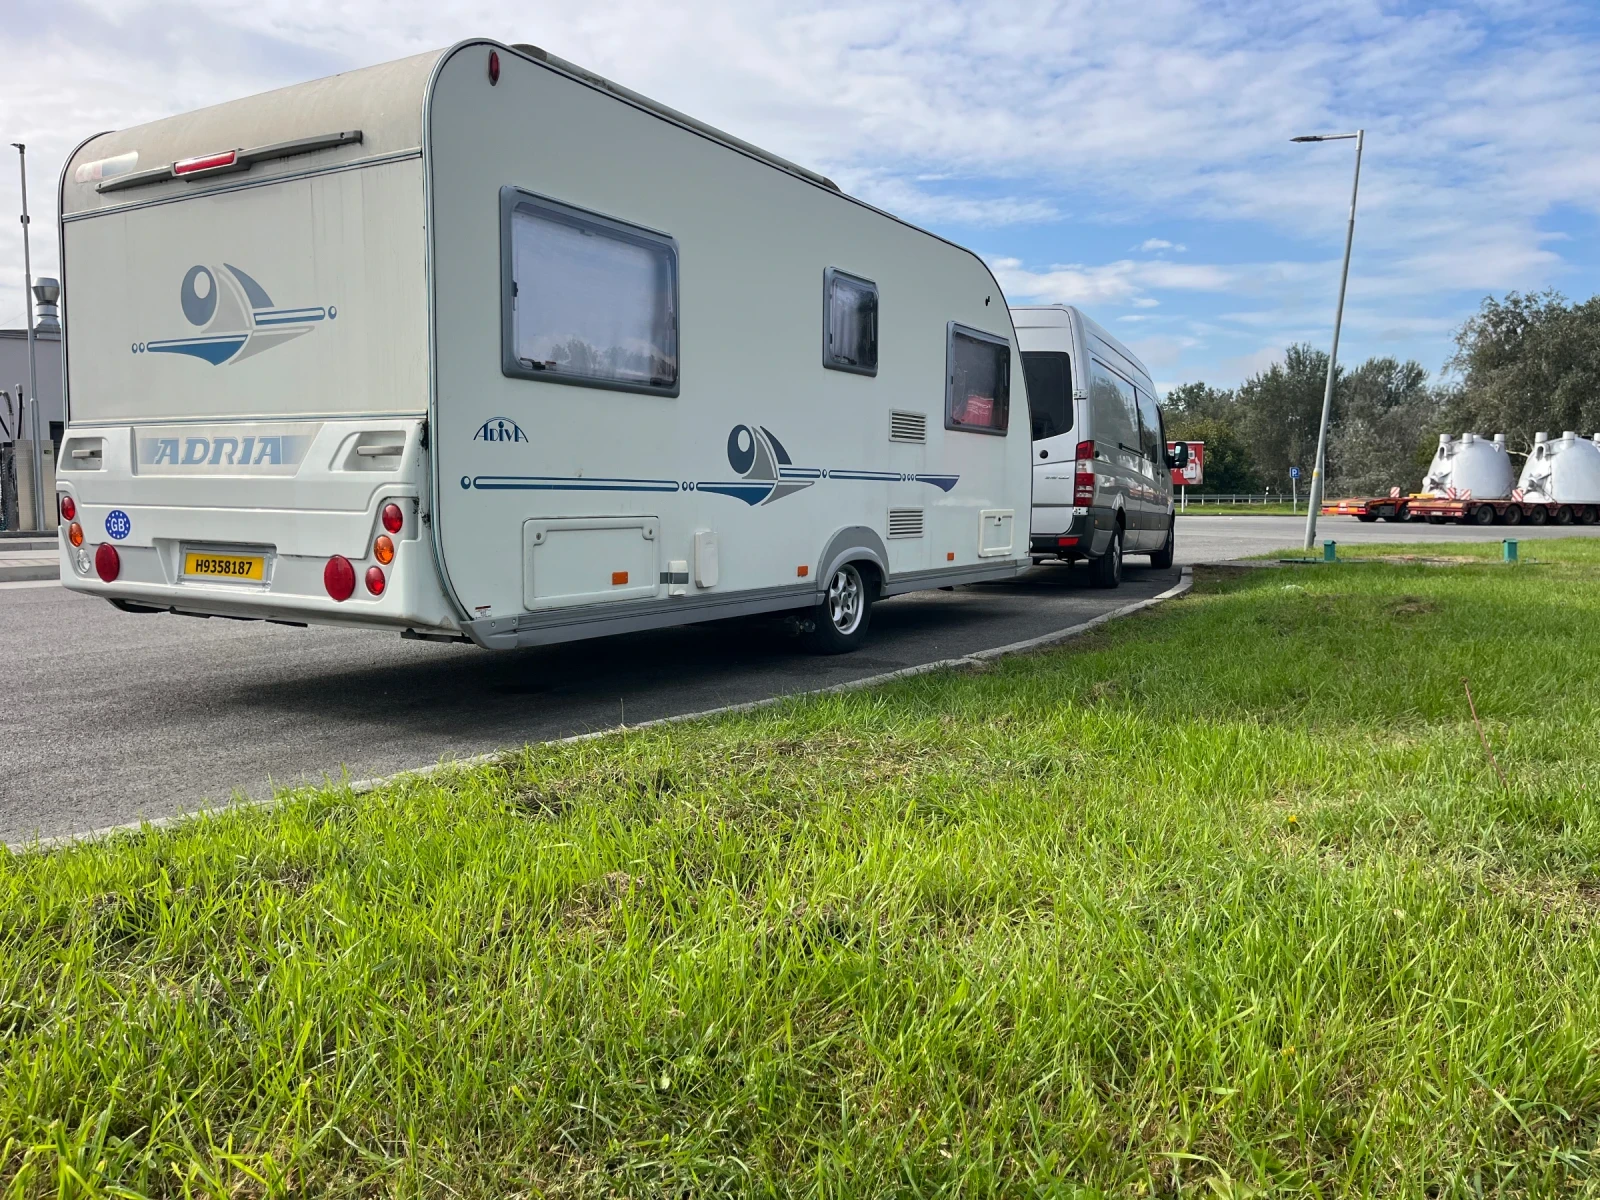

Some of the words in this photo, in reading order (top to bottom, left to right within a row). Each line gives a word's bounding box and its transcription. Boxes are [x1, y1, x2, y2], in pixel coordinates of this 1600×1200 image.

[153, 436, 282, 465] ADRIA
[110, 518, 125, 532] GB
[195, 558, 253, 575] H9358187
